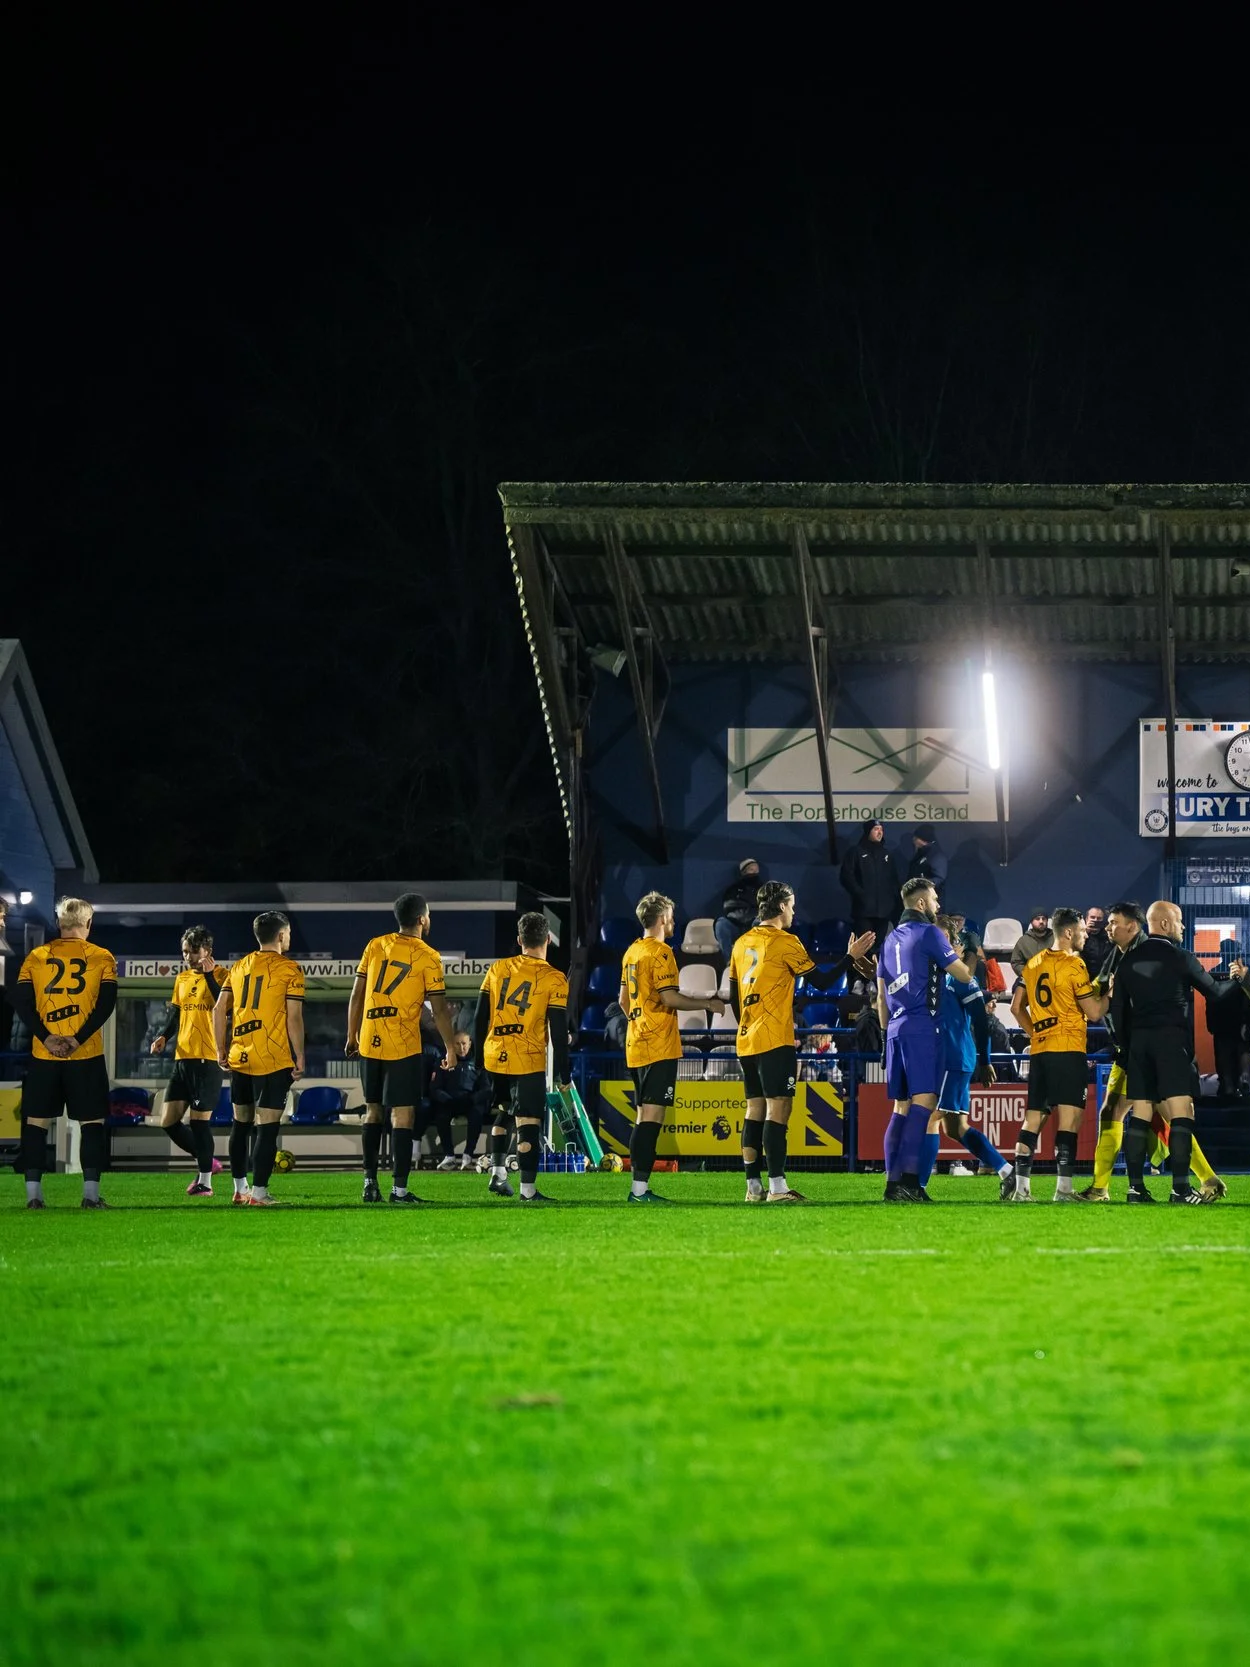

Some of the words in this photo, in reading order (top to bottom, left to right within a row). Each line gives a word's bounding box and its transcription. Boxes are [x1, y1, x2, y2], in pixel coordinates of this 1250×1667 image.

[1157, 777, 1203, 788] wecome
[1206, 773, 1218, 788] to
[747, 804, 783, 820] The
[790, 803, 906, 820] Porerhouse
[914, 804, 969, 820] Stand
[1212, 823, 1223, 832] the
[1226, 823, 1240, 834] boys
[1212, 874, 1241, 883] ONLY
[742, 947, 758, 985] 2
[895, 942, 901, 975] 1
[44, 958, 86, 994] 23
[240, 973, 264, 1010] 11
[373, 960, 411, 995] 17
[1035, 972, 1052, 1008] 6
[496, 976, 532, 1016] 14
[969, 1097, 1025, 1122] CHING
[661, 1121, 707, 1133] remier
